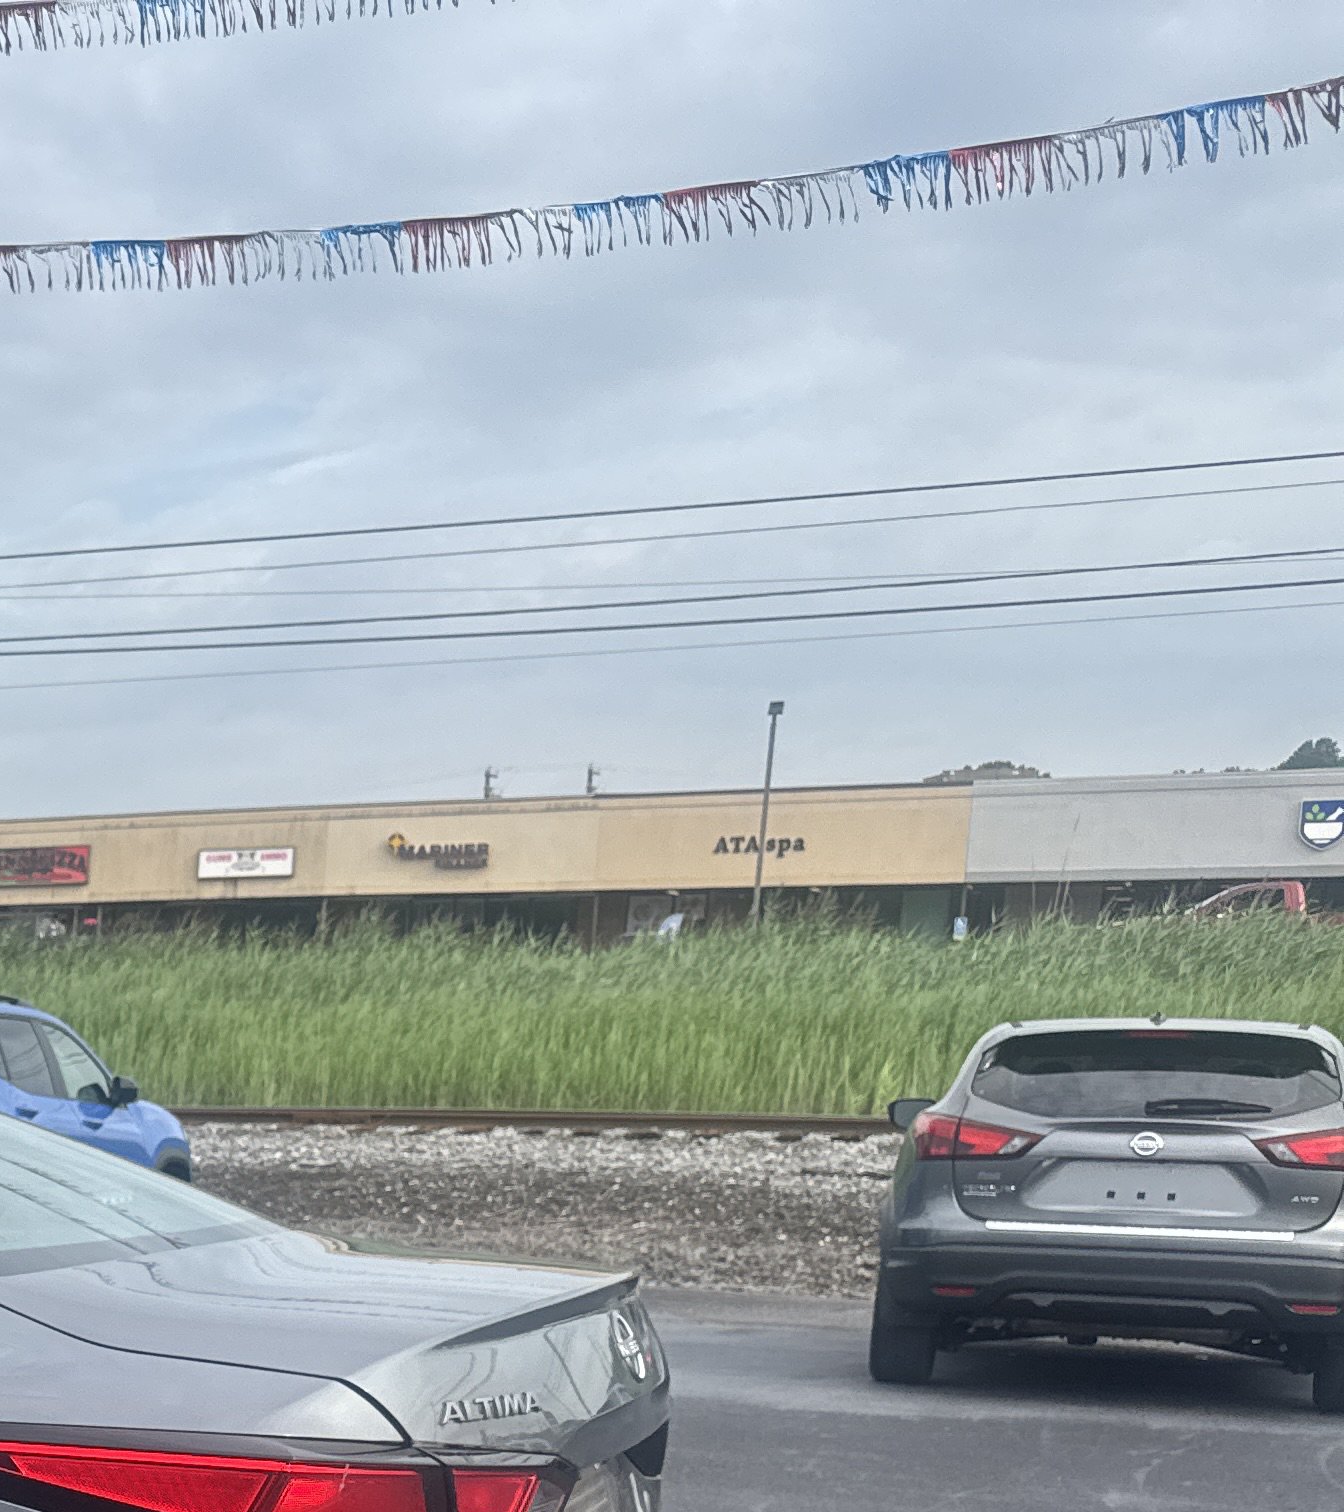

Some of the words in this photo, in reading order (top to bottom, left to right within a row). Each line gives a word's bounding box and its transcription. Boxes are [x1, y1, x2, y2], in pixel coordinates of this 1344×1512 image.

[399, 843, 488, 860] MARINER
[765, 838, 805, 858] spa
[1290, 1196, 1320, 1204] AWD
[440, 1391, 542, 1425] ALTIMA
